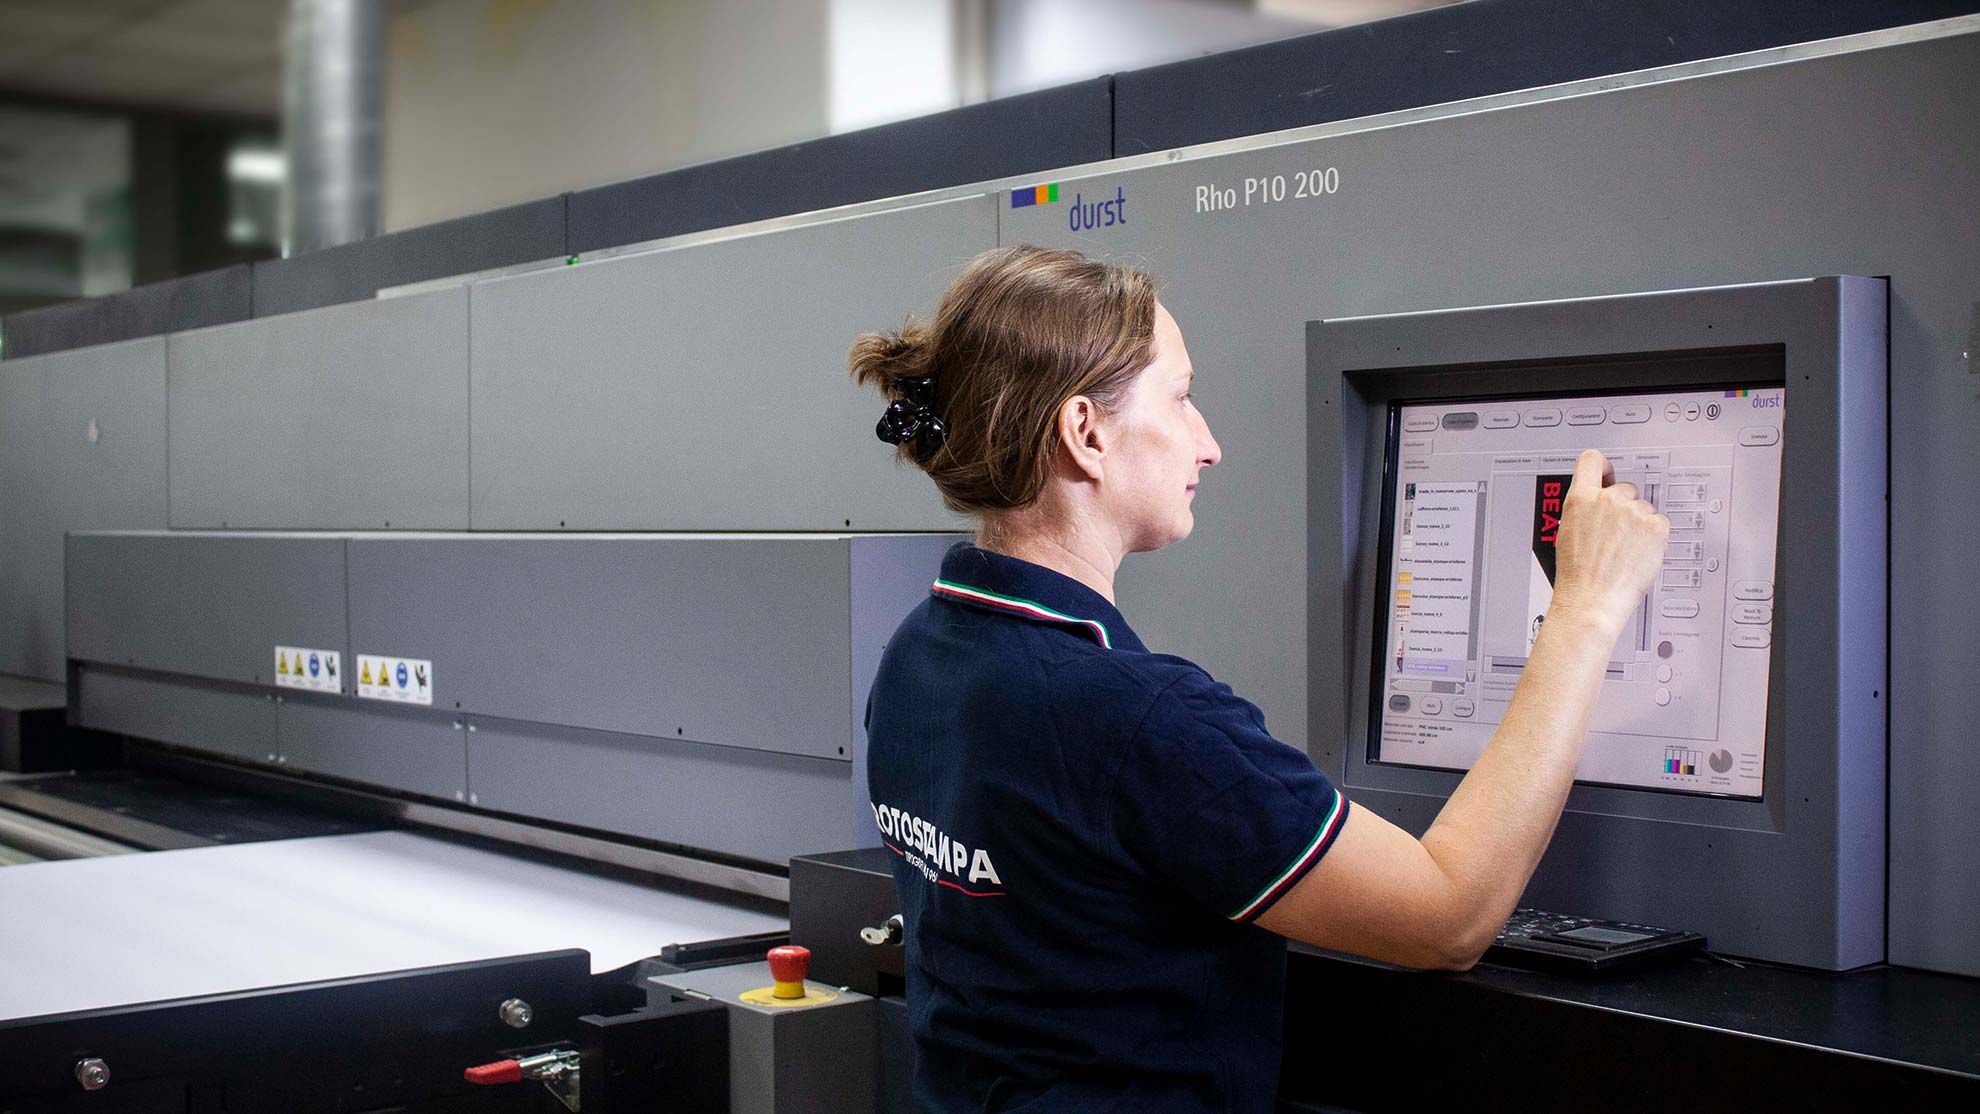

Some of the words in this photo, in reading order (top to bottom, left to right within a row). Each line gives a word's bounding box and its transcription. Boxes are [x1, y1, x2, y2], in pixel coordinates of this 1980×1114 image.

[1069, 186, 1127, 232] durst
[1196, 184, 1236, 213] Rho
[1244, 175, 1286, 207] P10
[1294, 166, 1340, 200] 200
[1752, 393, 1780, 409] durst
[1541, 482, 1562, 547] BEAT
